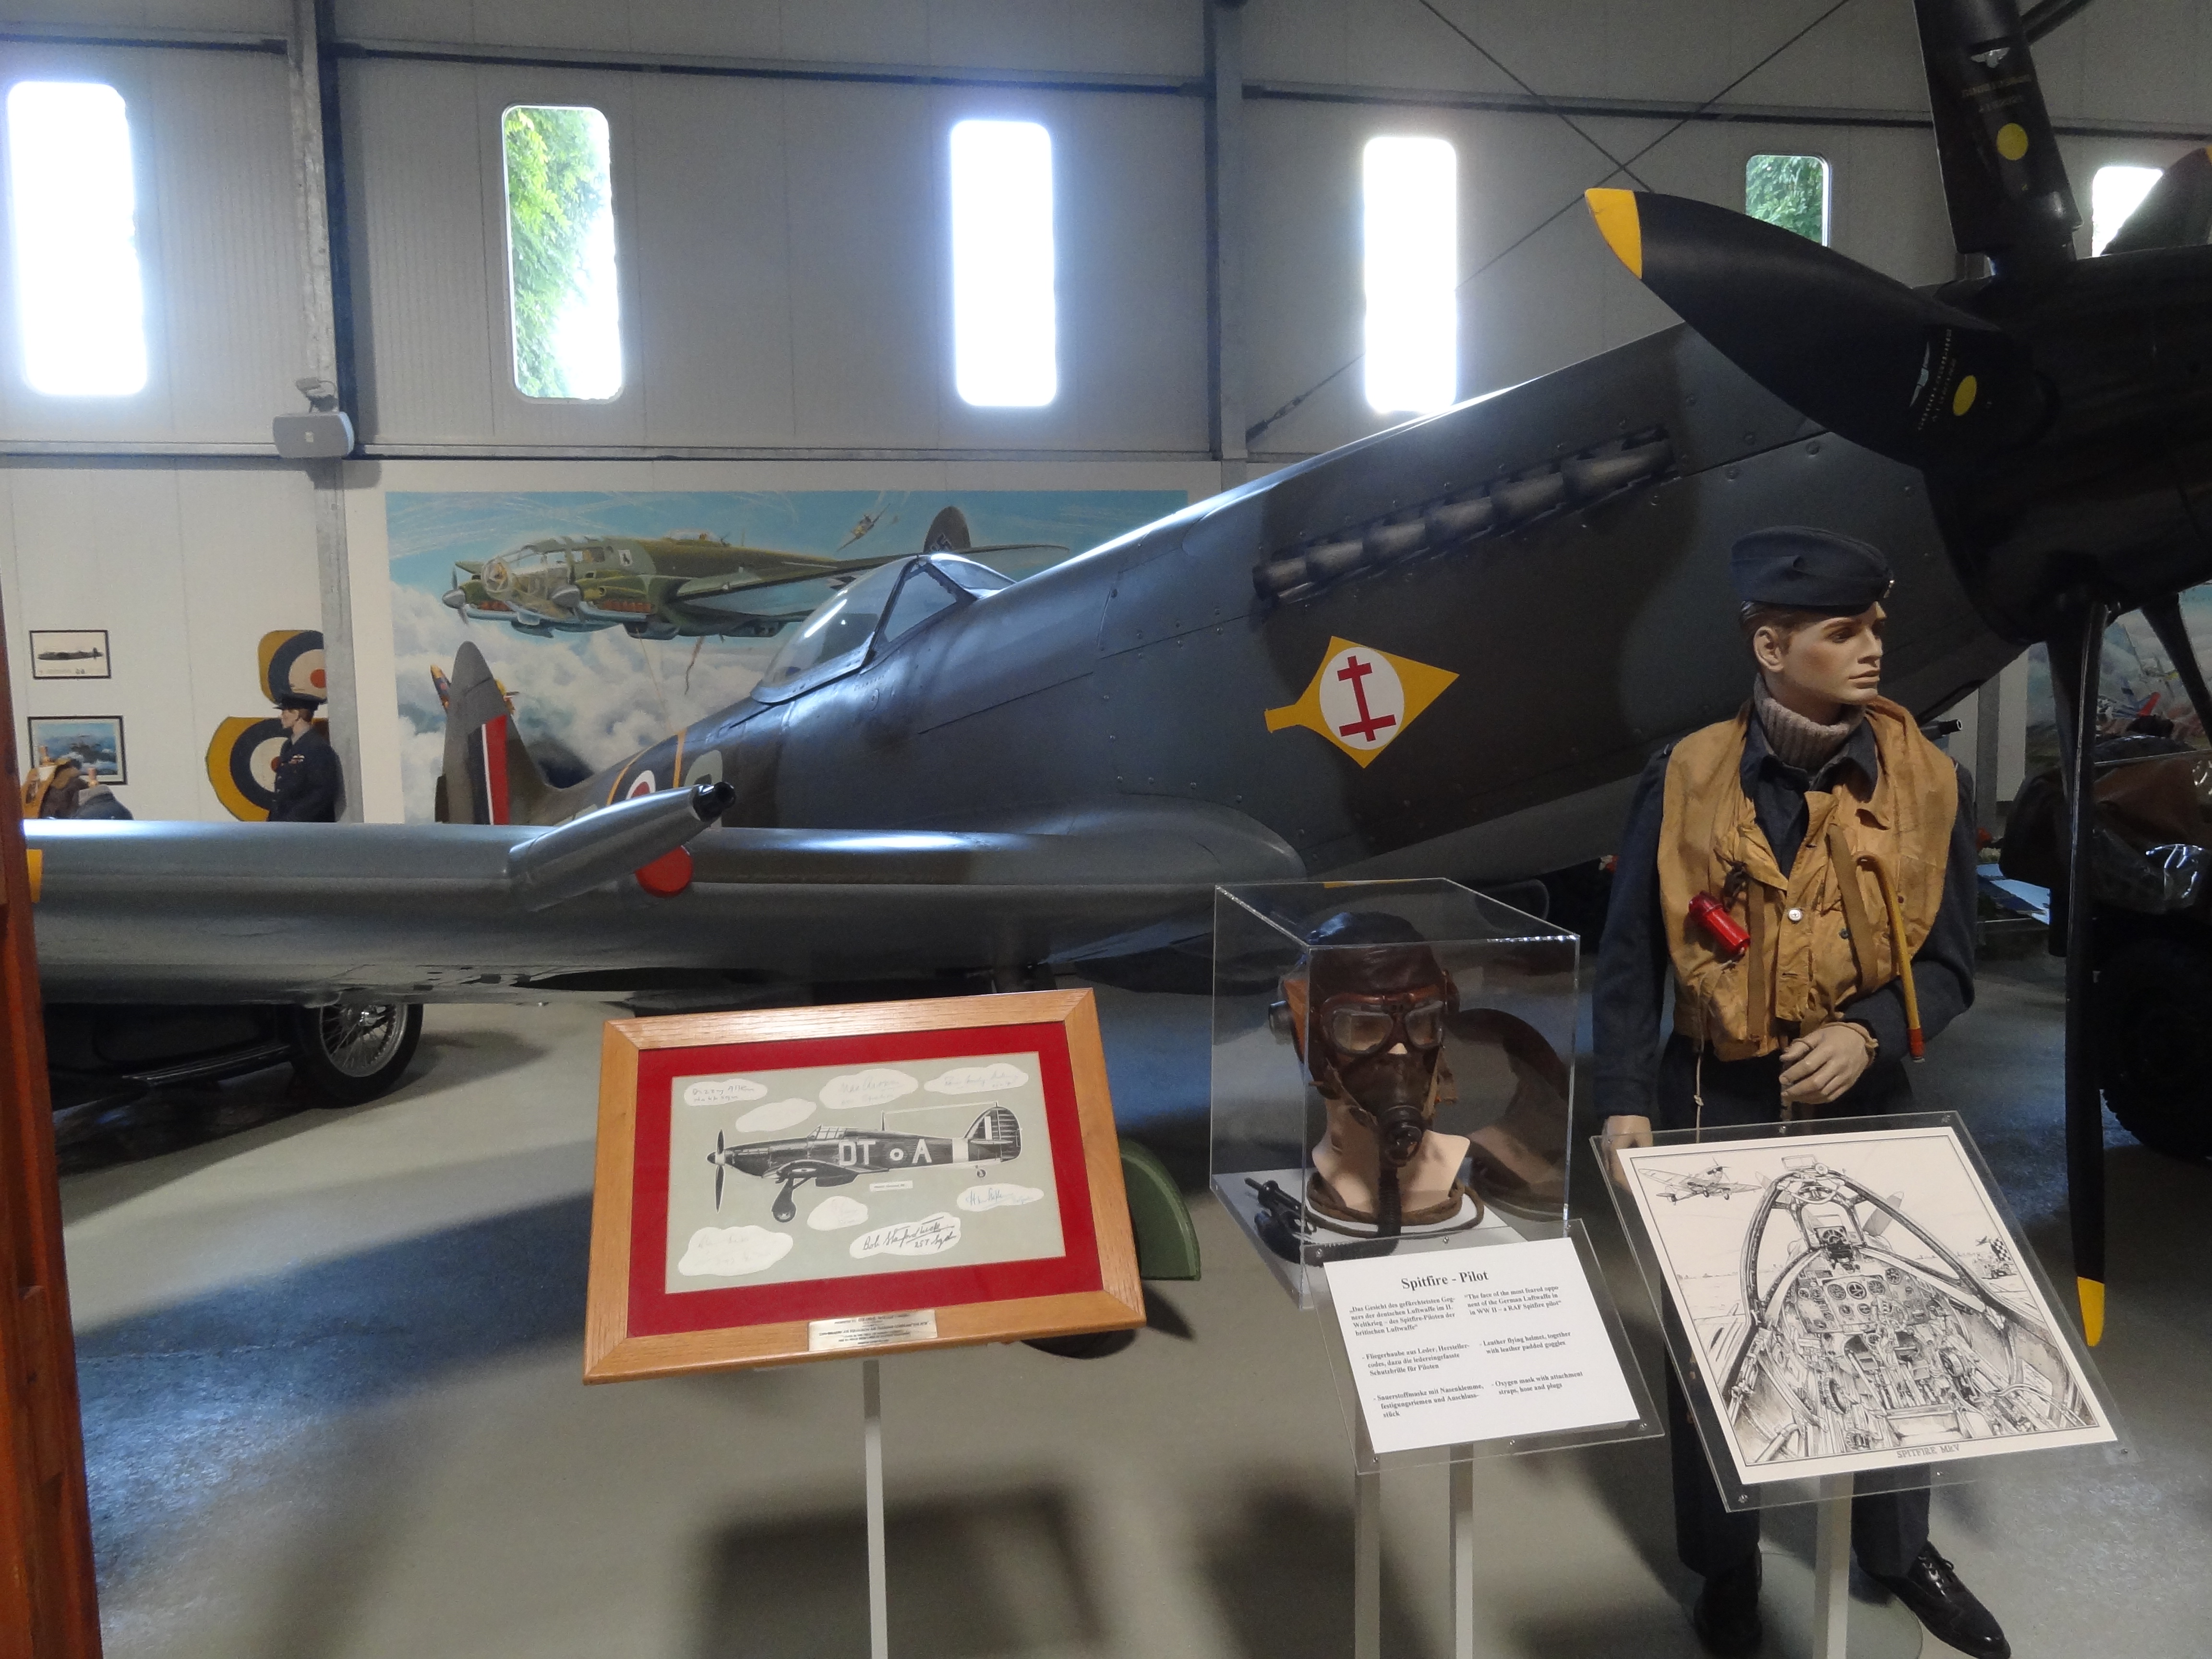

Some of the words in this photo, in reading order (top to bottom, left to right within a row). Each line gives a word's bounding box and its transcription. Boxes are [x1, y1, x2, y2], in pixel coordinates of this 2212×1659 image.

[912, 1139, 932, 1163] A
[1401, 1275, 1449, 1291] Spitfire
[1459, 1271, 1489, 1283] Pilot
[1523, 1343, 1543, 1351] padded
[1544, 1341, 1566, 1349] goggles
[1366, 1351, 1405, 1360] Fliegerhaube
[1370, 1367, 1406, 1376] Schutzbrille
[1551, 1371, 1583, 1380] attachment
[1377, 1391, 1427, 1401] Sauerstoffmaske
[1897, 1446, 1937, 1458] SPITFIRE
